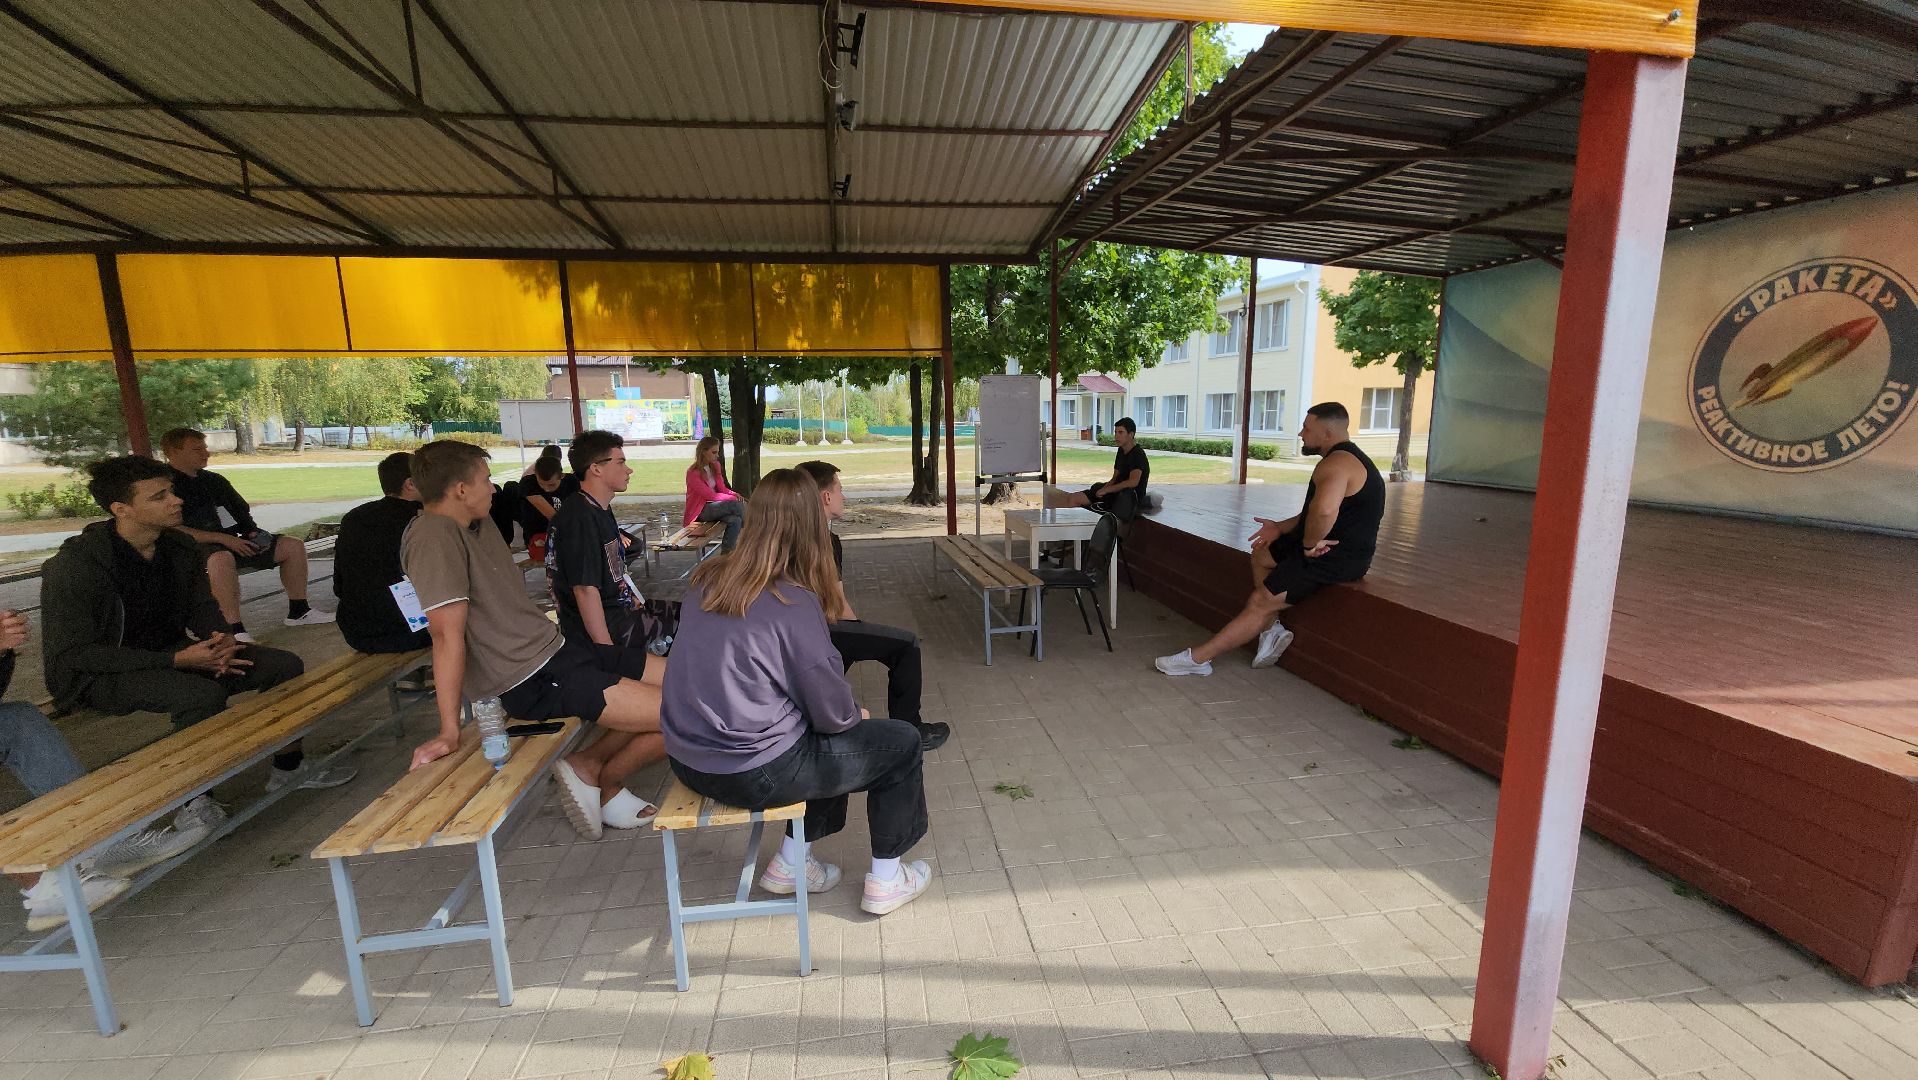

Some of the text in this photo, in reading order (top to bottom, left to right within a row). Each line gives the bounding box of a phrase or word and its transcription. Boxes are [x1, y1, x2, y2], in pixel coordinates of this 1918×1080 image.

[1734, 265, 1899, 323] «РАКЕТА»
[1697, 380, 1909, 463] РЕАКТИВНОЕ ЛЕТО!
